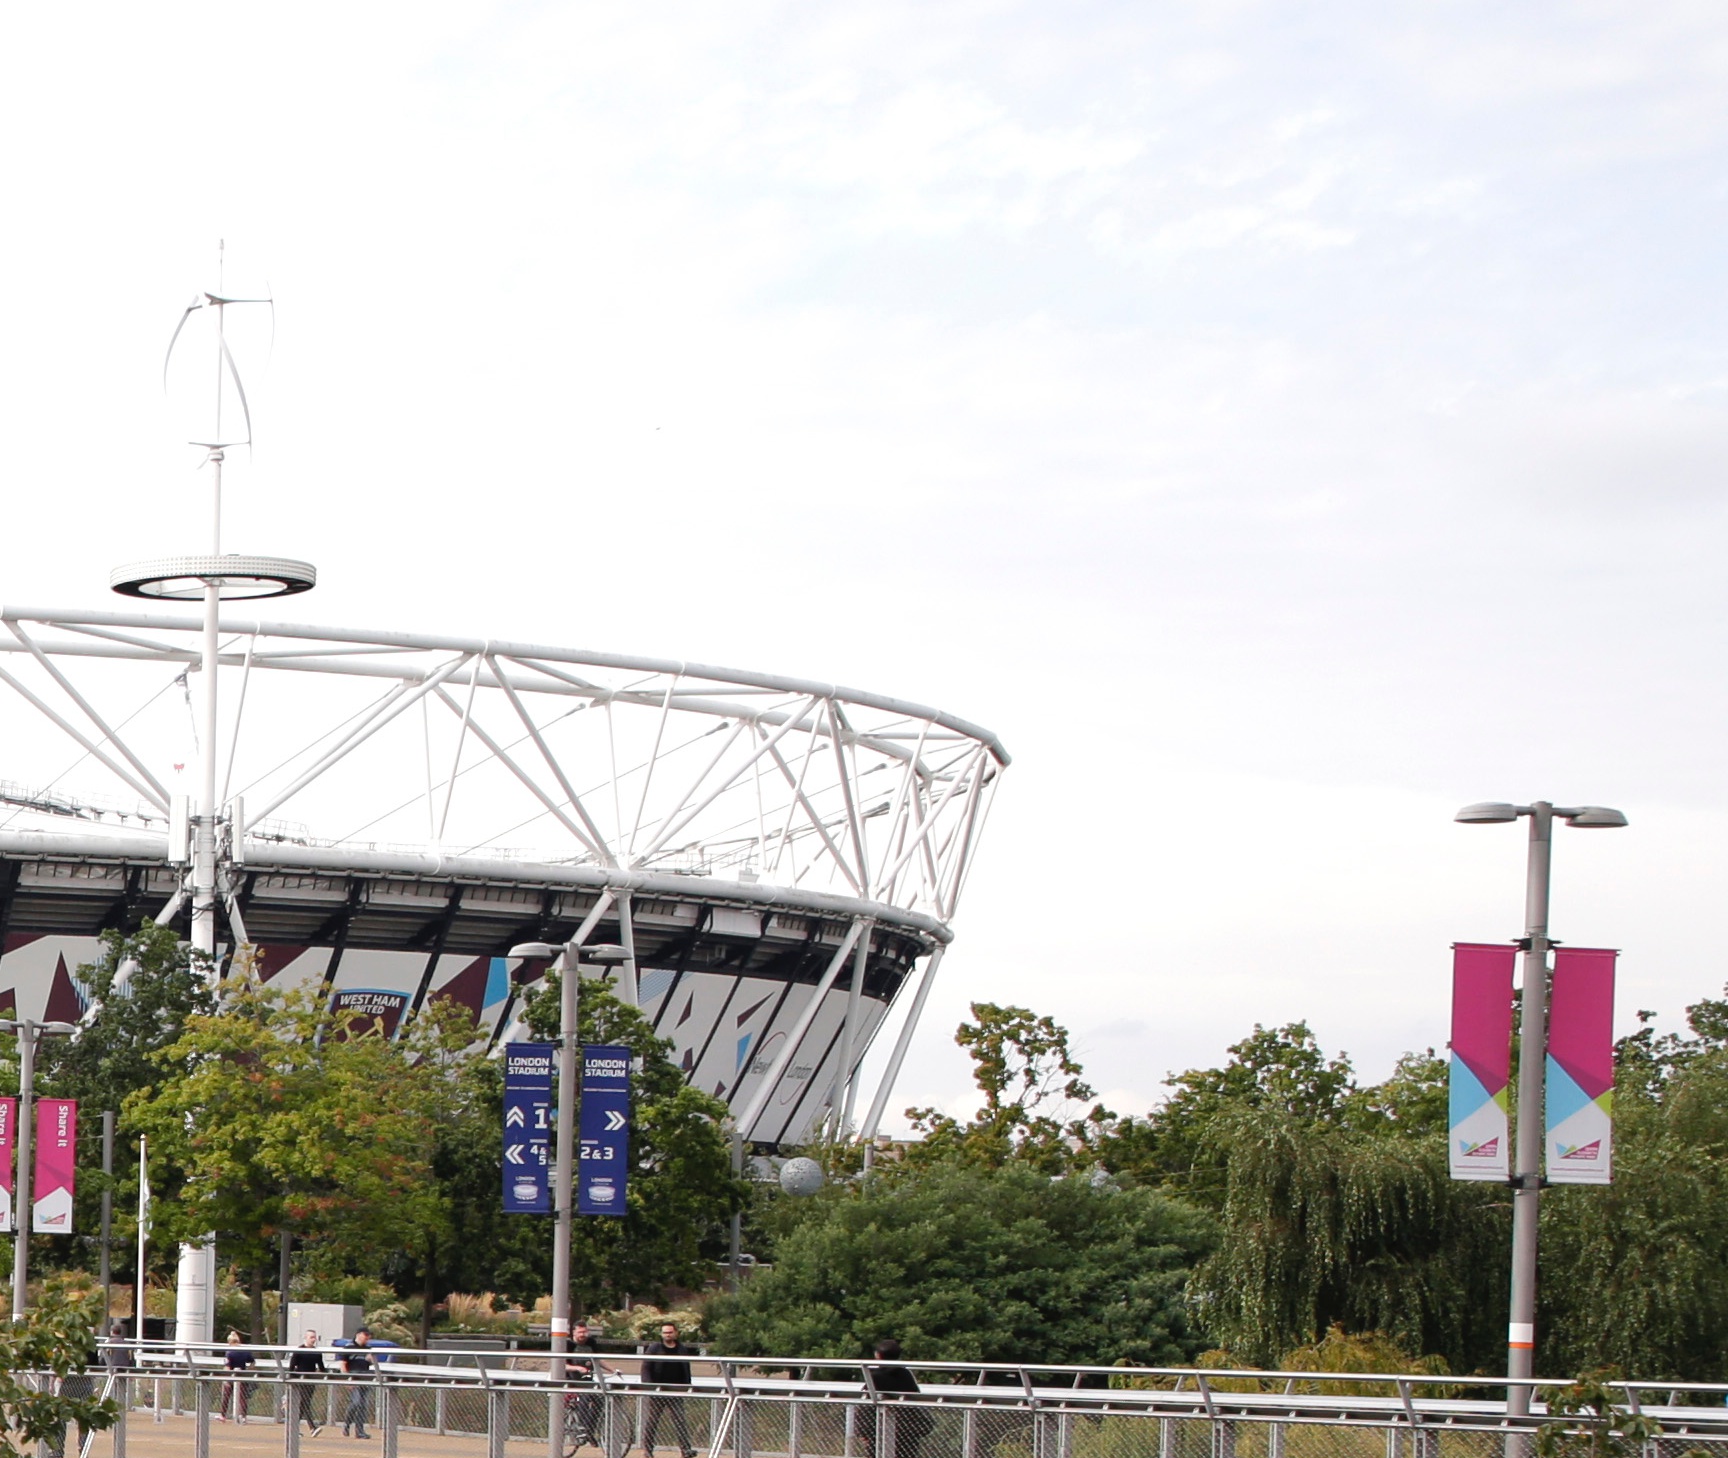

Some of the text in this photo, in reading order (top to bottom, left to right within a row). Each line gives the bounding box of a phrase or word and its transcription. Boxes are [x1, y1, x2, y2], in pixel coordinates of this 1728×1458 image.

[340, 994, 400, 1008] WEST HAM
[508, 1057, 549, 1066] LONDON
[585, 1059, 626, 1068] LONDON
[507, 1067, 549, 1075] STADIUM
[584, 1069, 626, 1077] STADIUM
[57, 1105, 68, 1137] Share
[534, 1108, 548, 1129] 1
[538, 1156, 547, 1166] 5
